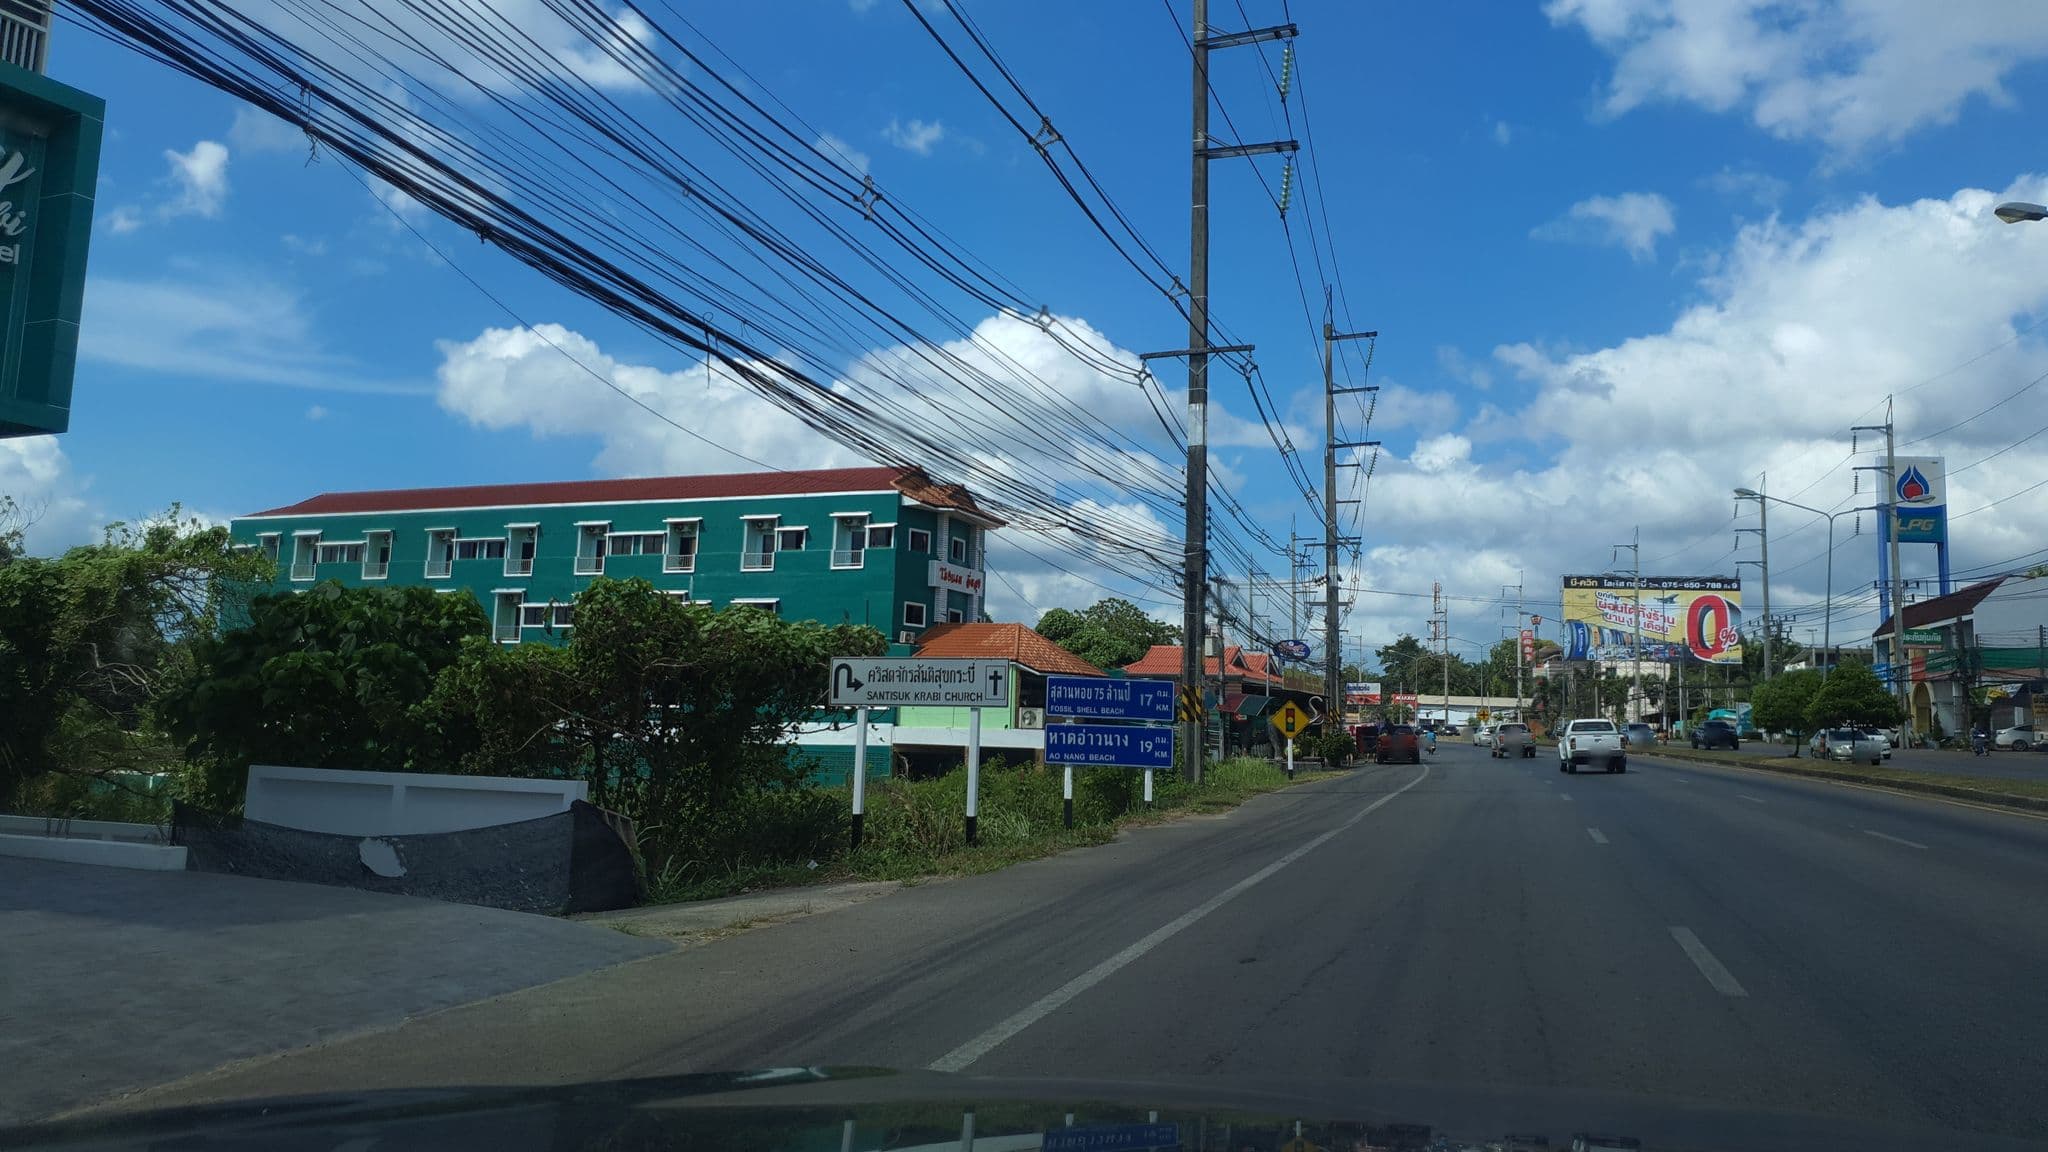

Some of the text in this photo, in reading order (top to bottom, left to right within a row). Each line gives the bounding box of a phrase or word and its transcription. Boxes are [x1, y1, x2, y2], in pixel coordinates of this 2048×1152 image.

[1898, 518, 1936, 533] LPG
[867, 690, 983, 702] SANTISUK KRABI CHURCH
[1095, 686, 1104, 700] 75
[1140, 693, 1153, 706] 17
[1050, 704, 1074, 713] FOSSIL
[1076, 706, 1098, 714] SHELL
[1101, 707, 1125, 715] BEACH
[1049, 728, 1129, 747] หาดอ่าวนาง
[1140, 740, 1153, 753] 19
[1049, 752, 1061, 760] AO
[1063, 753, 1085, 761] NANG
[1089, 754, 1115, 762] BEACH
